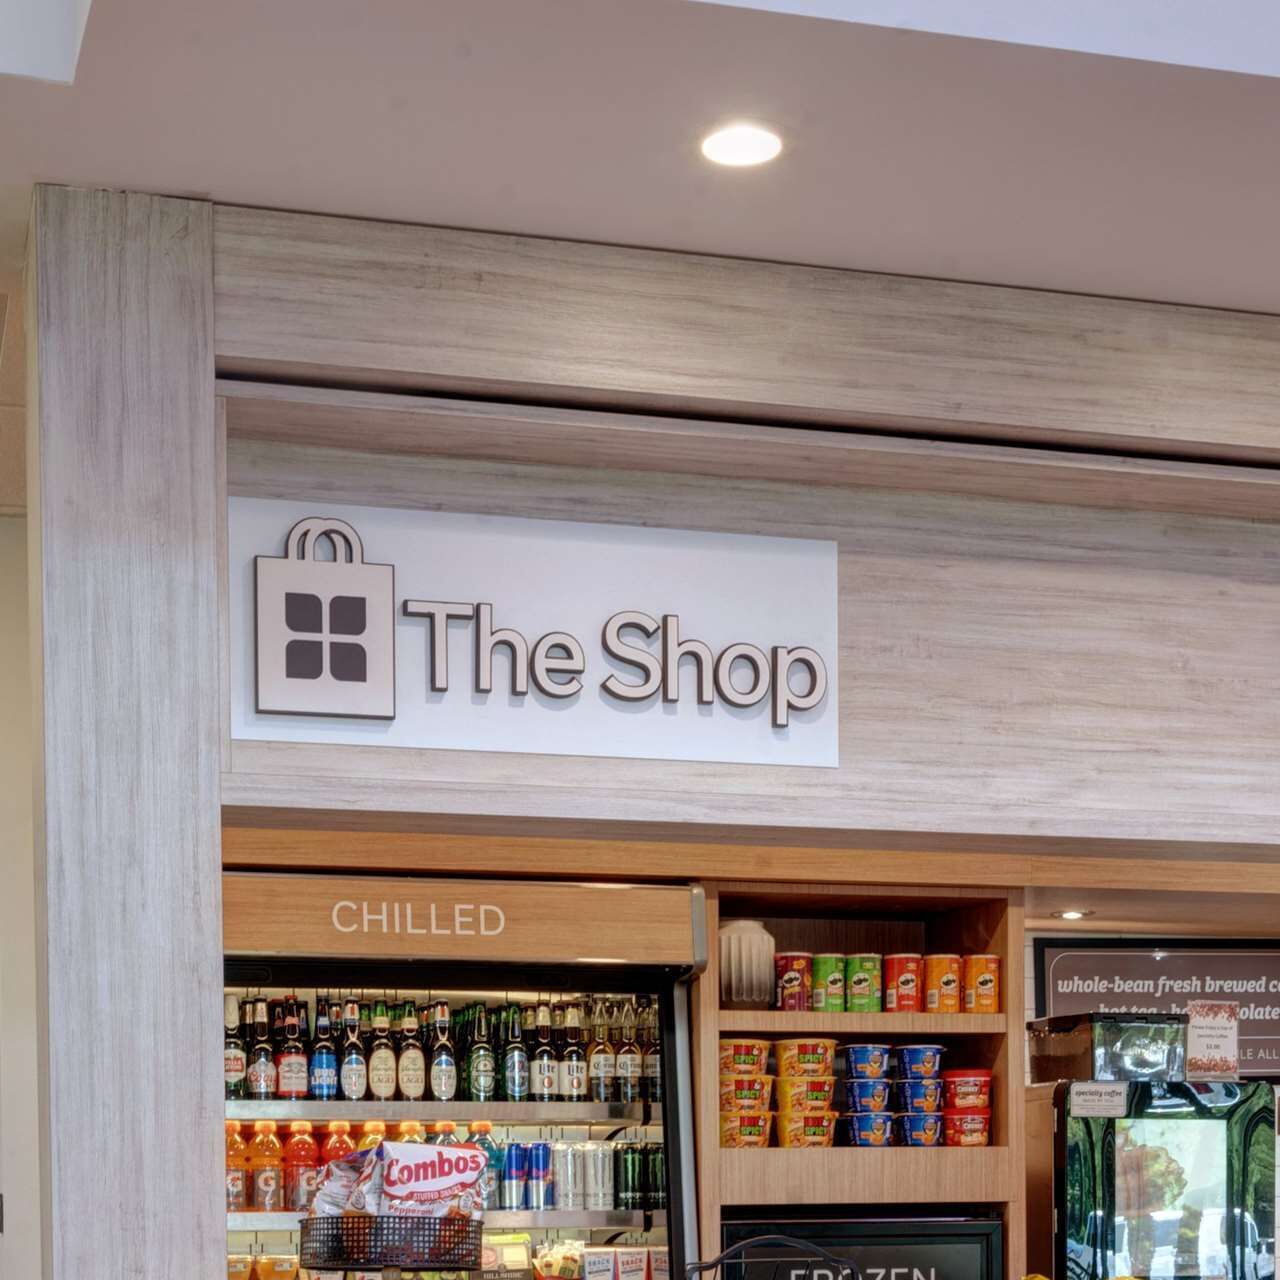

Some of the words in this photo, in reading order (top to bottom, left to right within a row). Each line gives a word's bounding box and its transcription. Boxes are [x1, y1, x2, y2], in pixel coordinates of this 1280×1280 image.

[403, 599, 585, 697] The
[601, 611, 827, 728] Shop
[331, 901, 505, 936] CHILLED
[1057, 976, 1154, 993] whole-bean
[1155, 976, 1201, 997] fresh
[1205, 977, 1264, 993] brewed
[1239, 1004, 1280, 1020] olate
[1257, 1048, 1280, 1060] ALL
[383, 1151, 482, 1188] Combos
